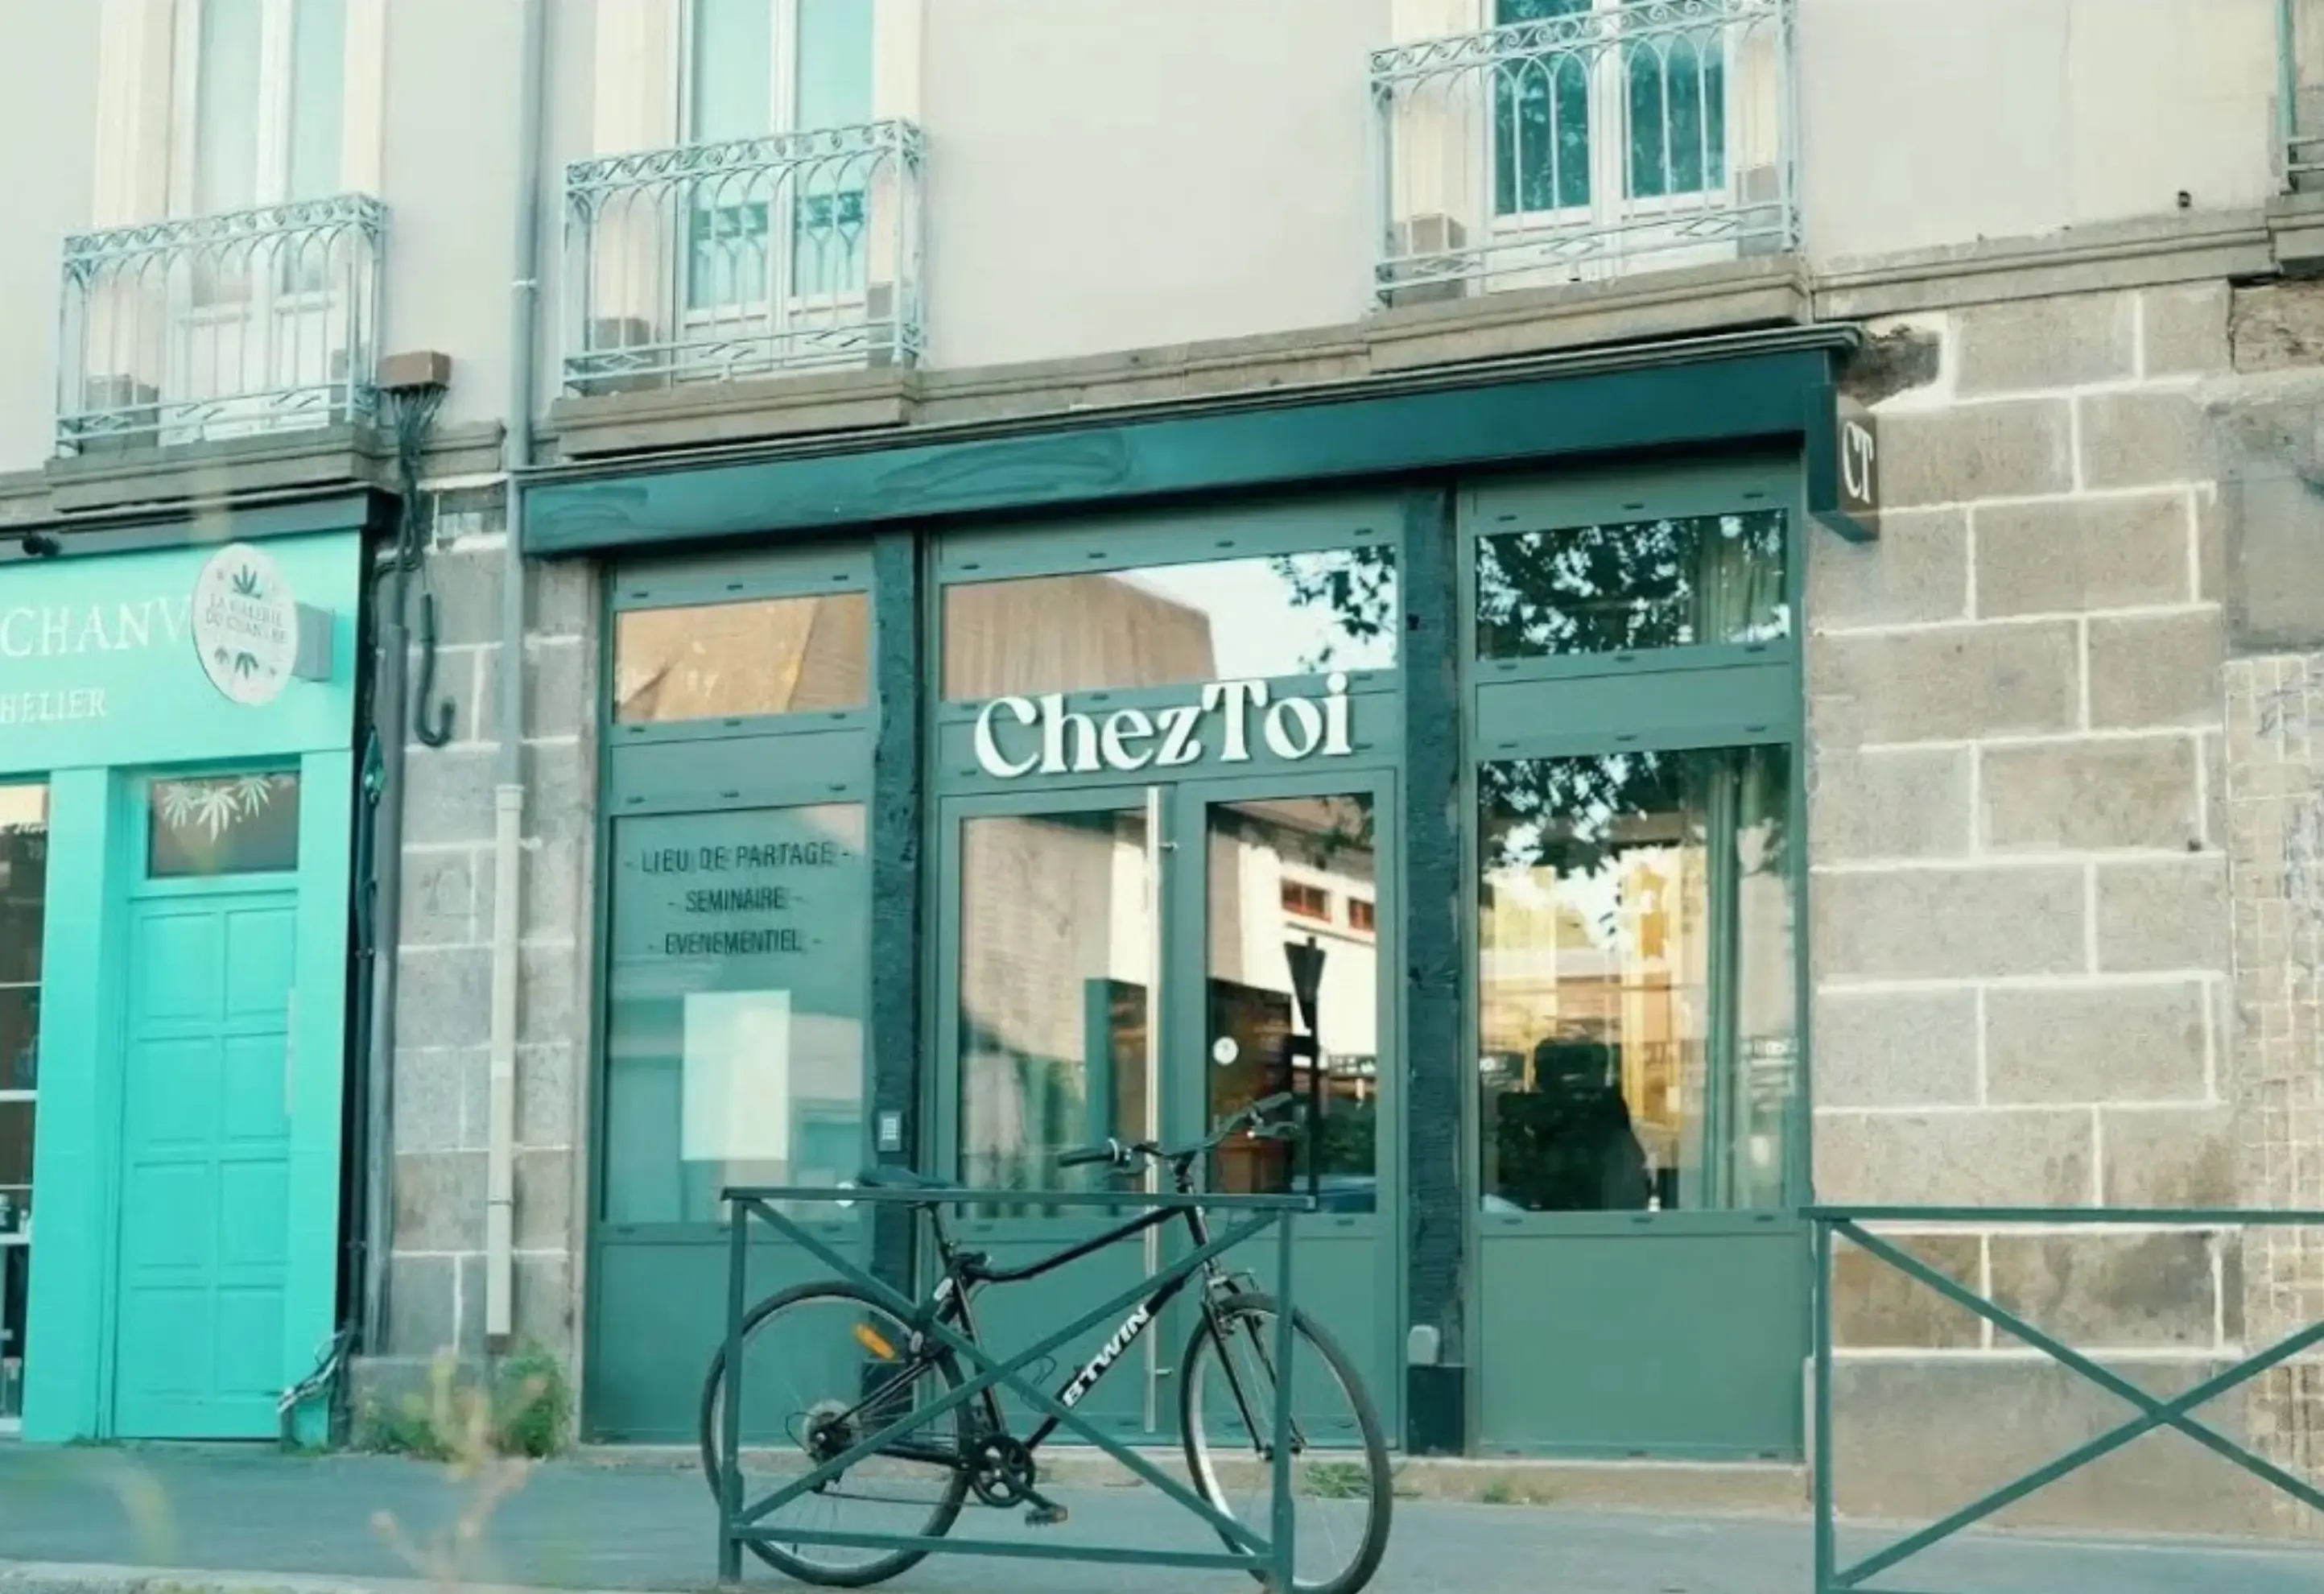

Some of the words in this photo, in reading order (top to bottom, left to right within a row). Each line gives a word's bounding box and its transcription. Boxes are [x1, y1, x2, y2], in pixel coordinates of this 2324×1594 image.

[642, 848, 689, 873] LIEU
[700, 846, 728, 871] DE
[736, 841, 834, 869] PARTAGE
[686, 886, 789, 913] SEMINAIRE
[665, 928, 804, 955] EVENEMENTIEL
